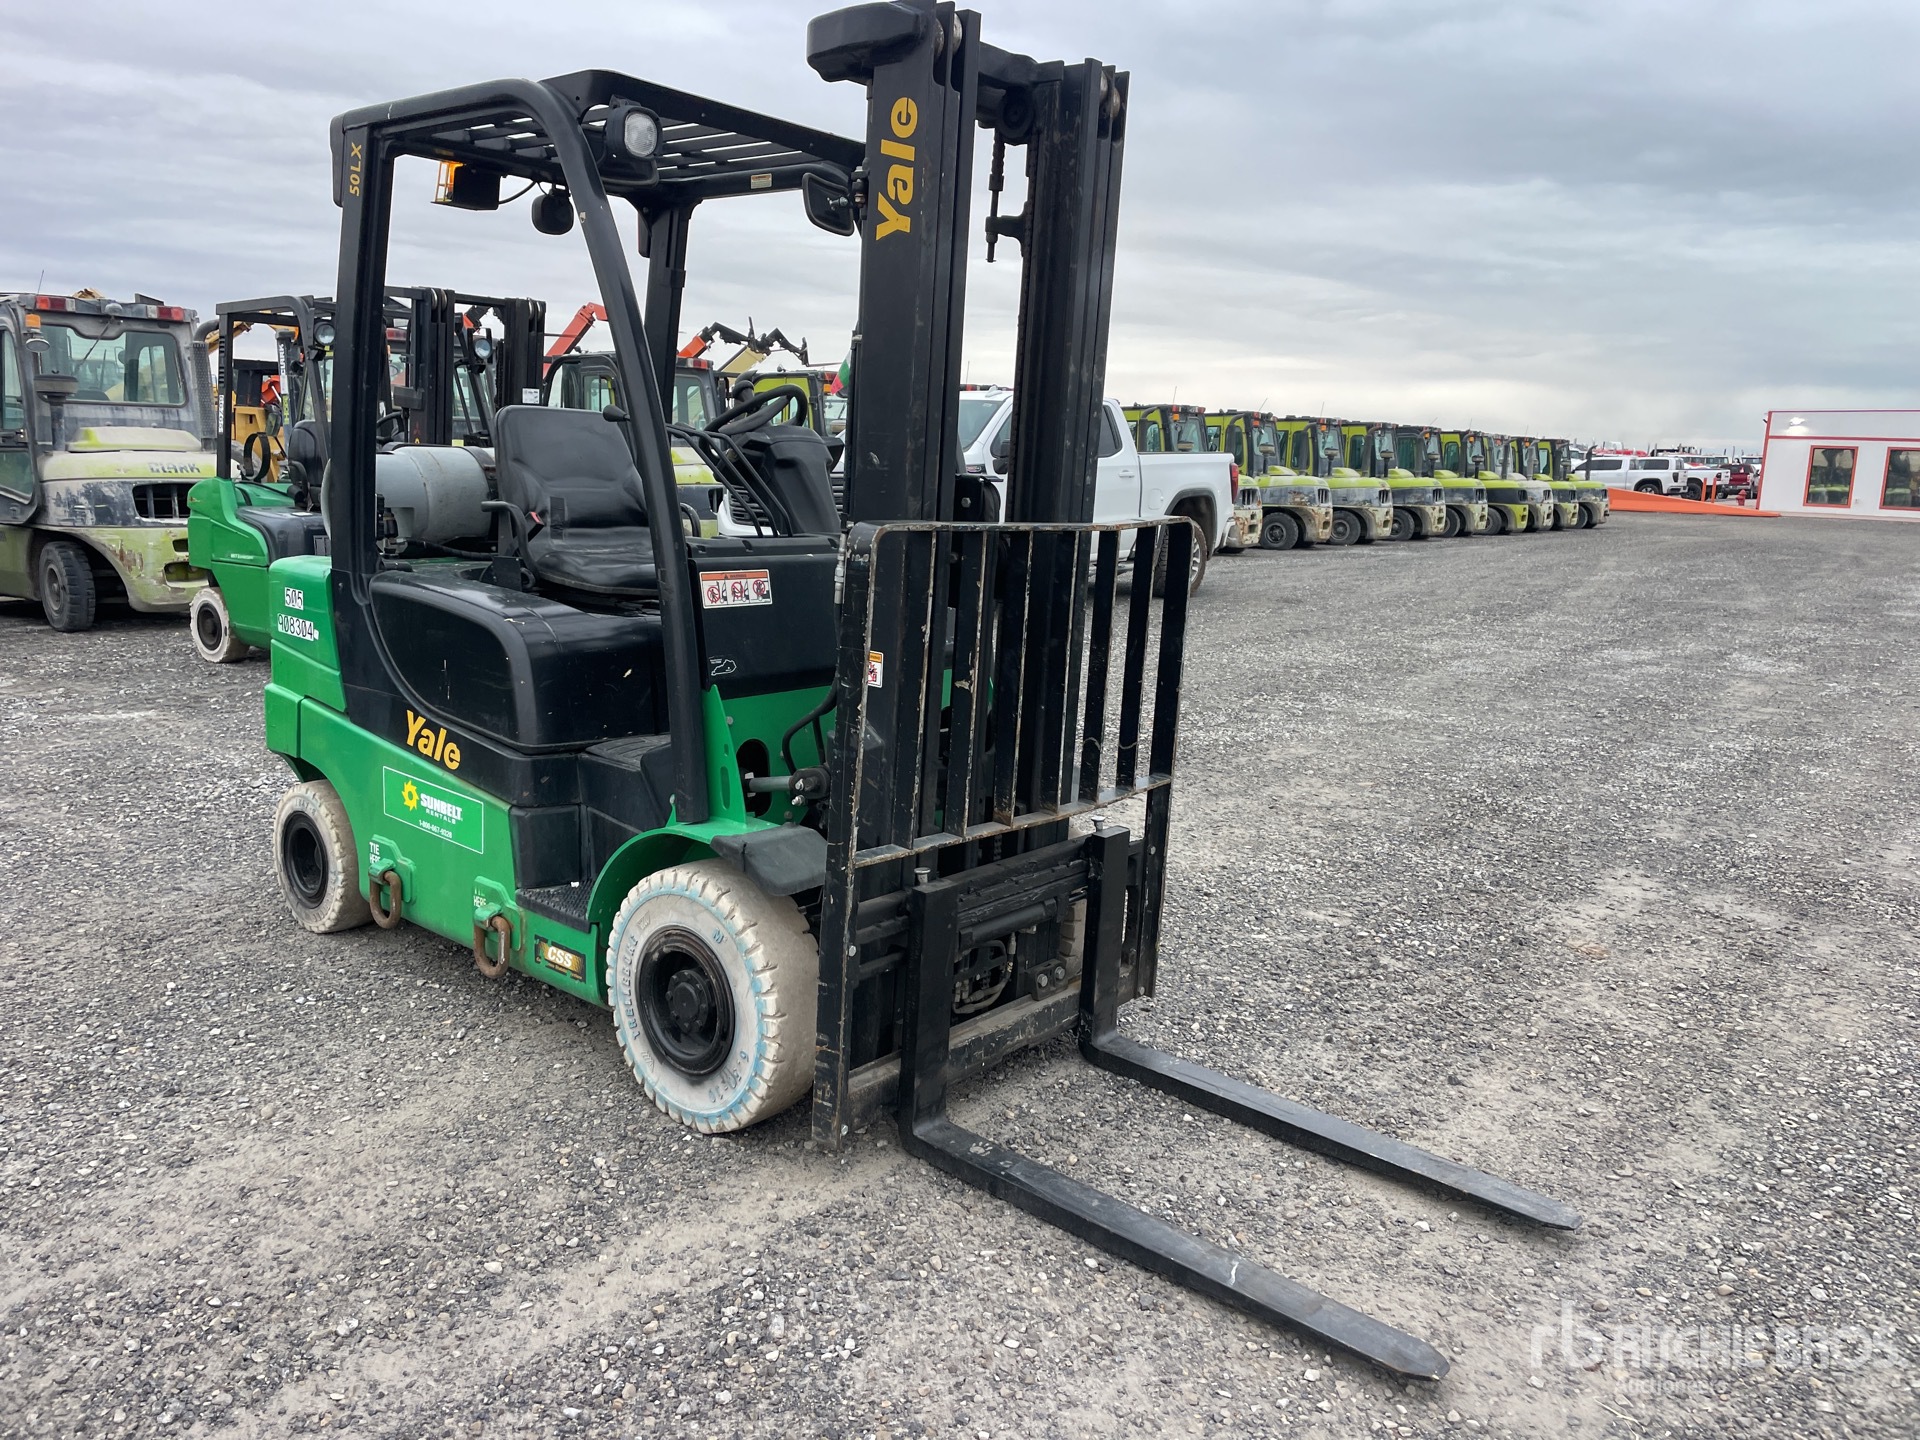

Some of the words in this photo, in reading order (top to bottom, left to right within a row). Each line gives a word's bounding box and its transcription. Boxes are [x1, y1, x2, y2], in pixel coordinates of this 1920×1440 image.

[349, 142, 362, 197] 50LX
[876, 97, 918, 241] Yale
[285, 588, 303, 609] 505
[278, 614, 313, 640] 908304
[406, 709, 461, 770] Yale
[420, 793, 463, 821] SUNBELT
[426, 808, 456, 825] RENTALS
[369, 841, 380, 856] TIE
[547, 945, 573, 968] CSS
